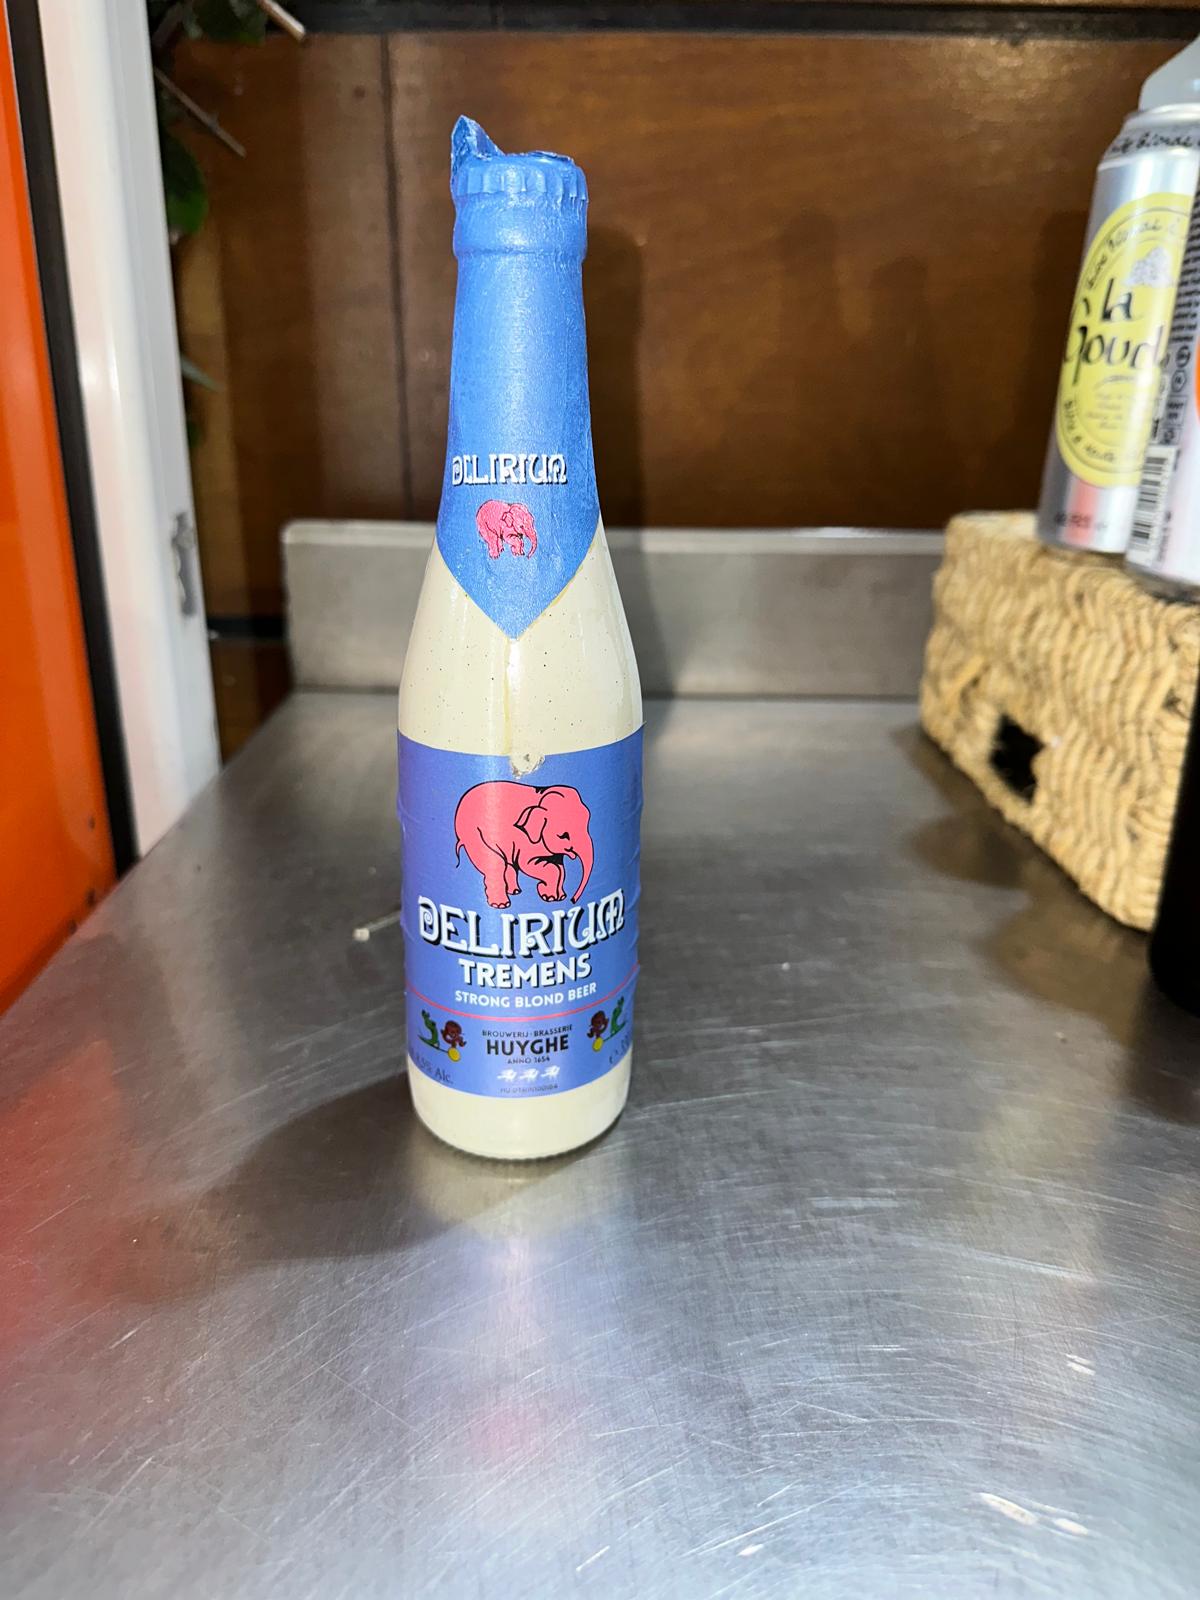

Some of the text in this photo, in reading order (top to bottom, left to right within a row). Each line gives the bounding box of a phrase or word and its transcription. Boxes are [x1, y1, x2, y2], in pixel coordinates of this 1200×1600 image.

[452, 453, 567, 485] DELIRIUM
[418, 888, 625, 958] DELIRIUM
[459, 953, 592, 988] TREMENS
[455, 982, 597, 1008] STRONG BLOND BEER
[482, 1024, 573, 1038] BROUWERIJ BRASSERIE
[486, 1034, 569, 1056] HUYGHE
[507, 1056, 532, 1065] ANNO
